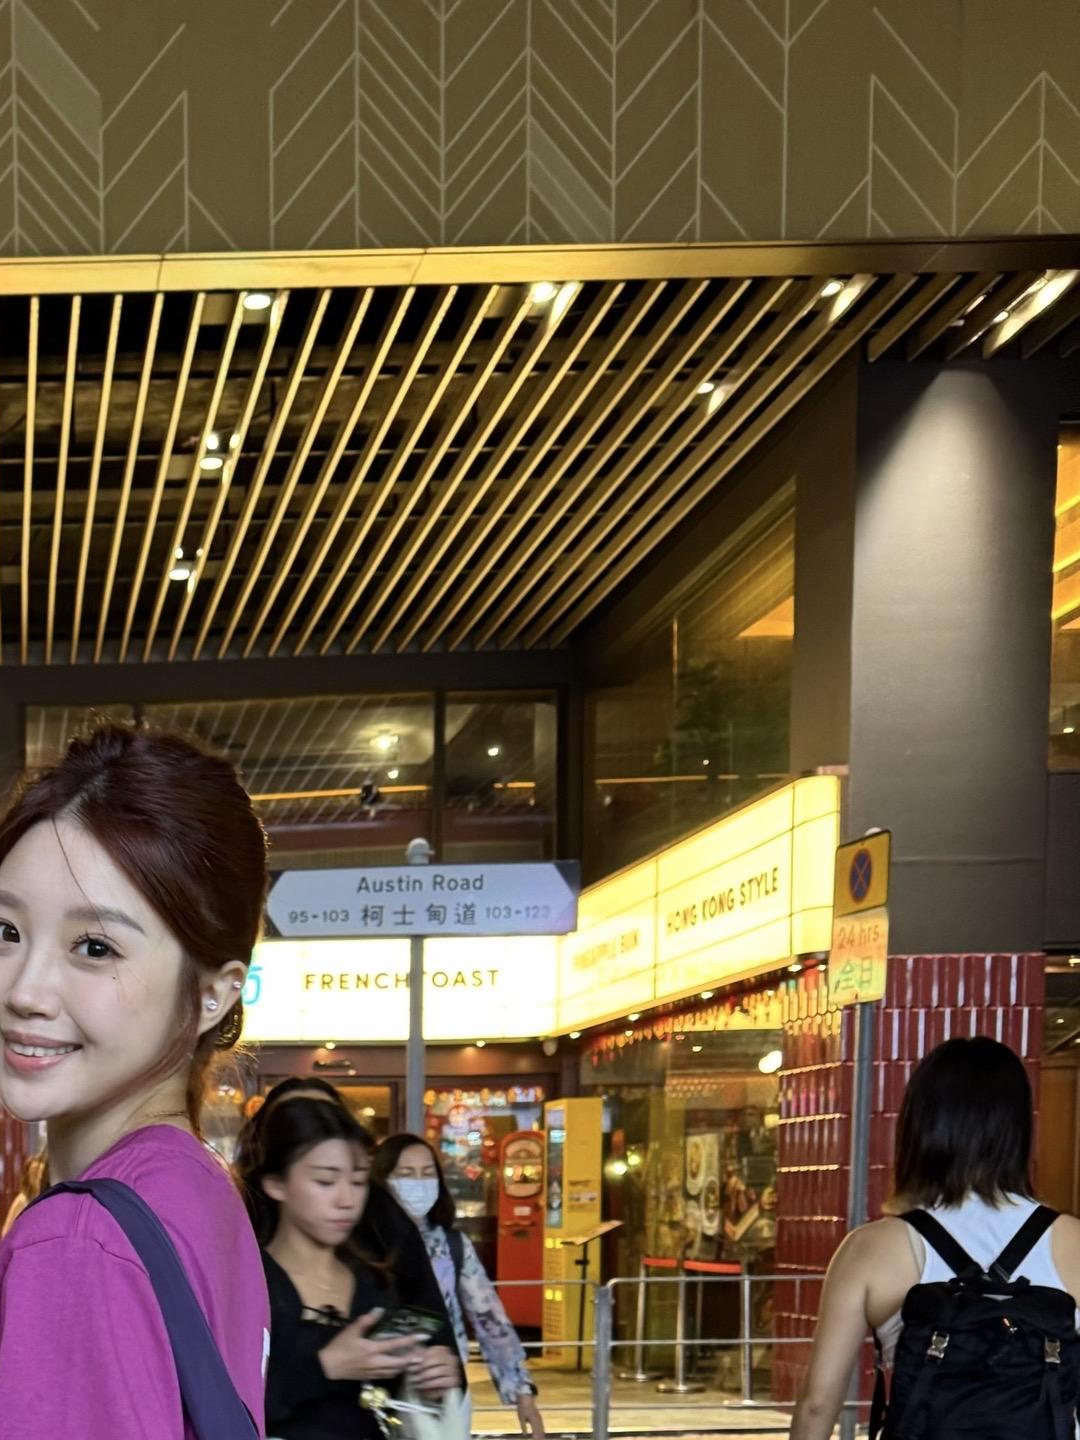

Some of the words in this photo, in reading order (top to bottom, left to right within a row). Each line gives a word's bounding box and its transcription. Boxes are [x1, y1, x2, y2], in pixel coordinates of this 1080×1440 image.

[356, 876, 423, 894] Austin
[432, 874, 484, 892] Road
[739, 866, 778, 906] STYLE
[288, 910, 350, 923] 95-103
[360, 903, 477, 927] 柯士甸道
[837, 924, 856, 950] 24
[304, 973, 410, 990] FRENCH
[422, 969, 499, 988] OAST
[840, 955, 873, 991] 全日
